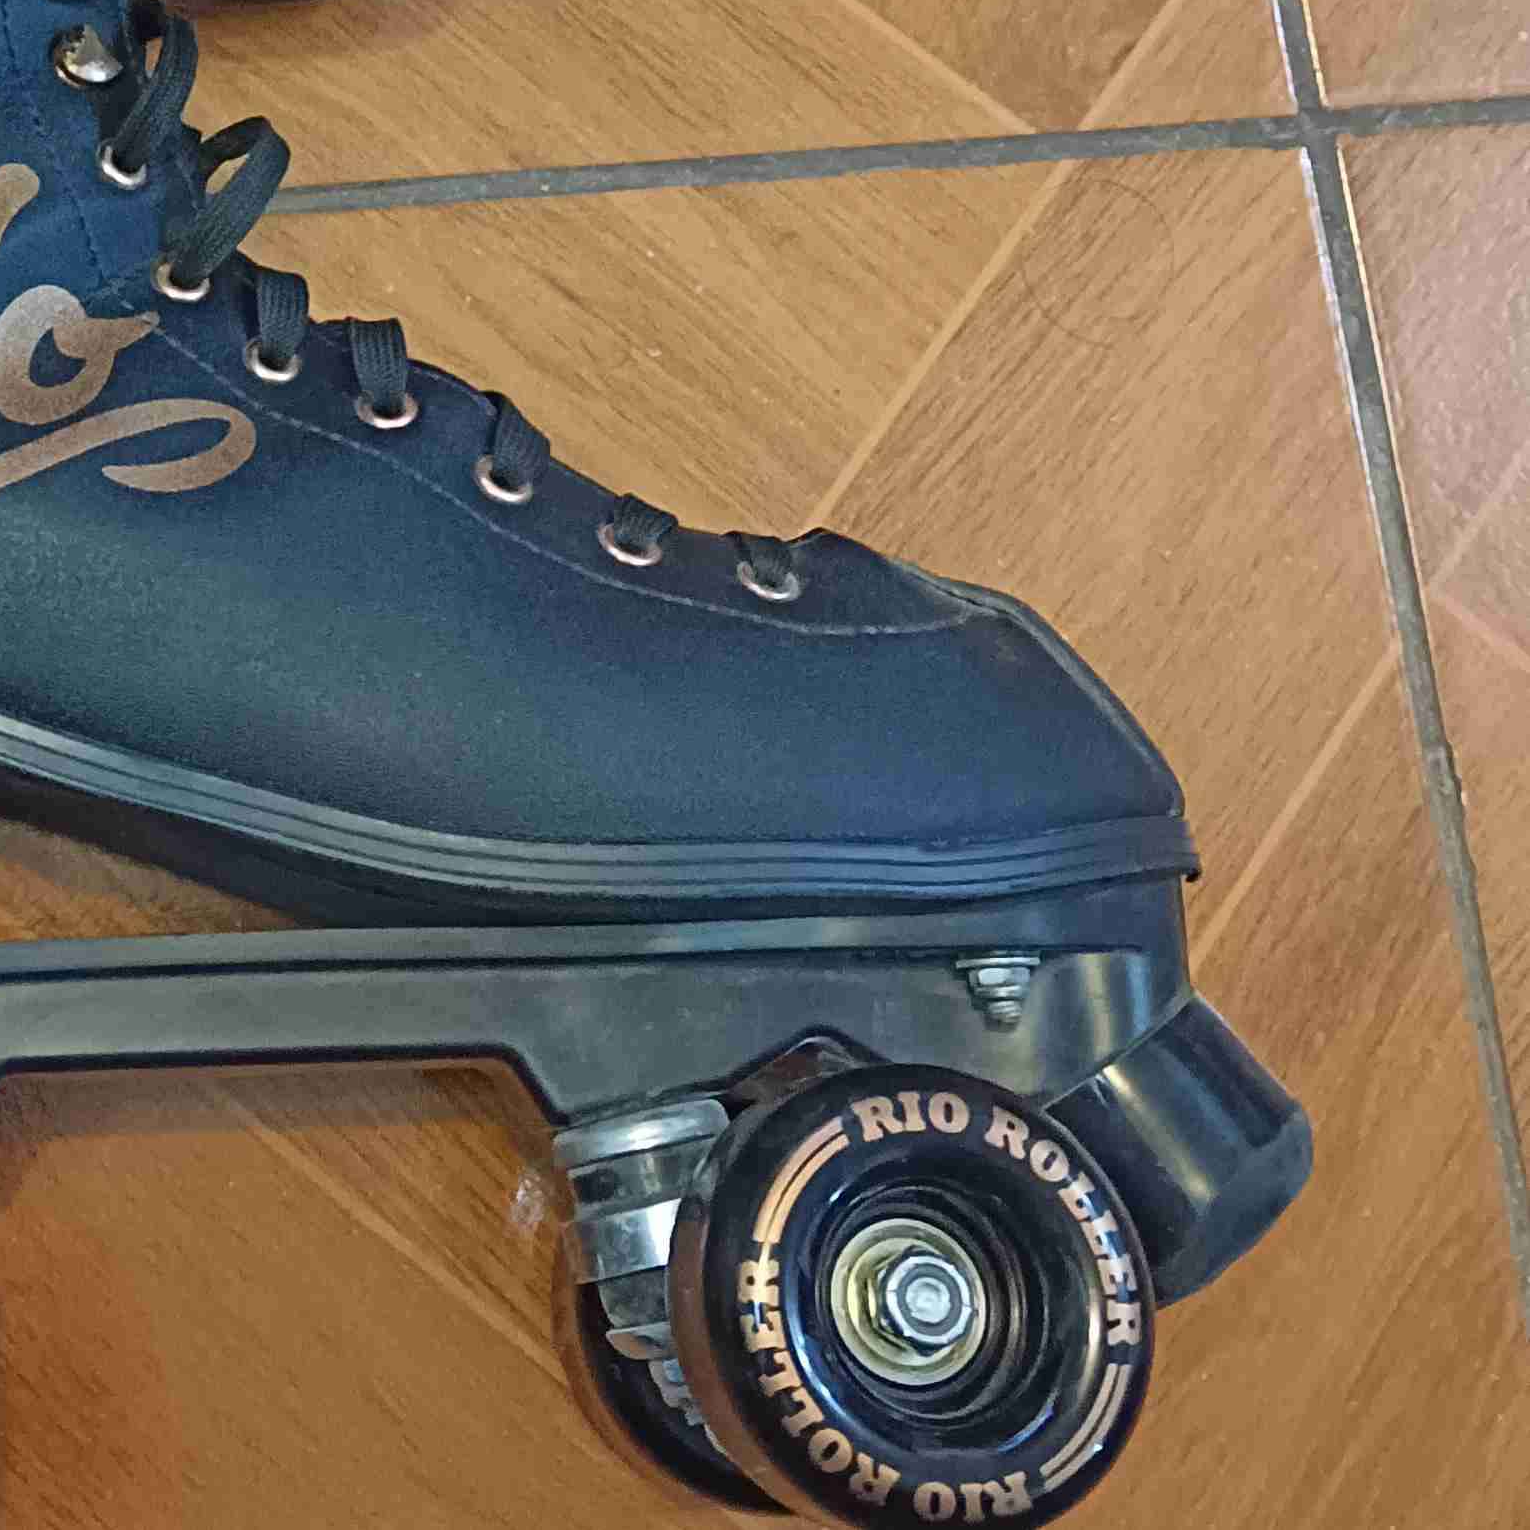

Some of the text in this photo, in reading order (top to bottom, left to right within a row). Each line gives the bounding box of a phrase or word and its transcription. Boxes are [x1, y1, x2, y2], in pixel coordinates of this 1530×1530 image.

[850, 1091, 1142, 1346] RIO ROLLER
[737, 1259, 1034, 1522] RIO ROLLER
